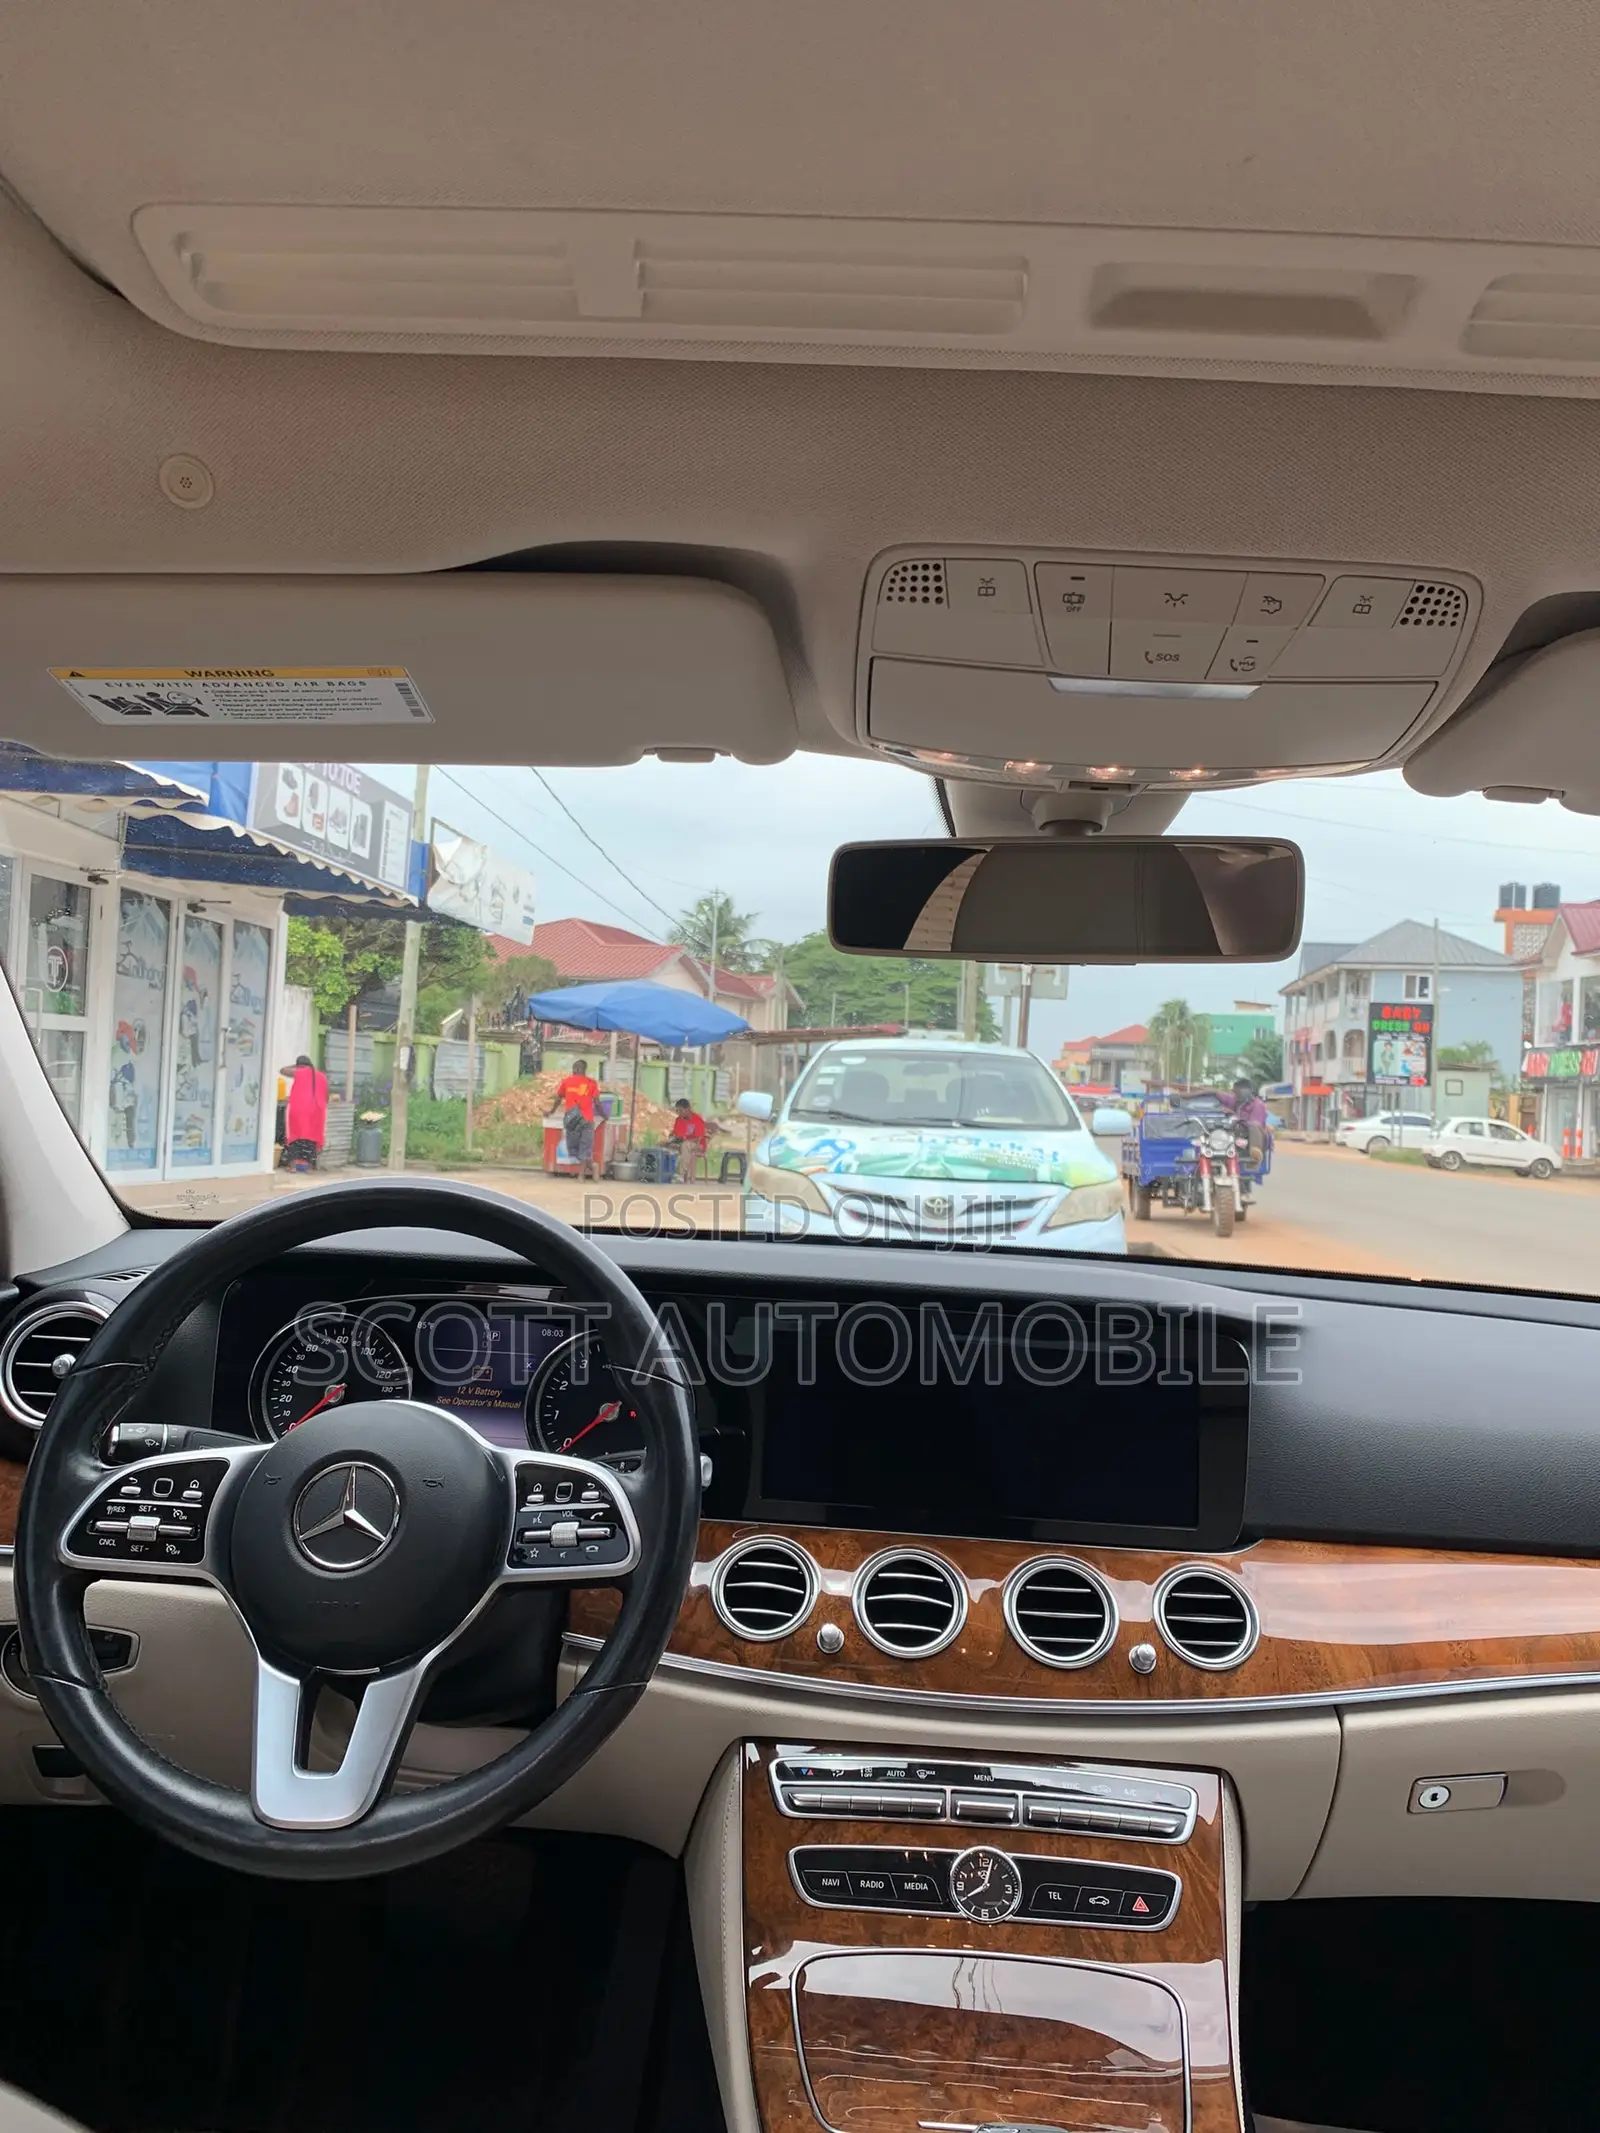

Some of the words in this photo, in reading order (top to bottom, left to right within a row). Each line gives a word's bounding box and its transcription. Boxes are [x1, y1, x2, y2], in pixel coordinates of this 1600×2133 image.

[1155, 652, 1180, 663] SOS
[184, 670, 275, 678] WARNING
[541, 1328, 564, 1337] 08:03
[336, 1336, 349, 1344] 80
[361, 1347, 376, 1356] 100
[374, 1358, 385, 1366] 110
[580, 1360, 588, 1369] 3
[285, 1366, 299, 1374] 40
[376, 1371, 392, 1379] 120
[559, 1380, 568, 1390] 2
[457, 1386, 465, 1394] 12
[475, 1387, 503, 1398] Battery
[279, 1395, 293, 1403] 20
[436, 1396, 452, 1405] See
[452, 1397, 492, 1407] Operator's
[492, 1400, 522, 1409] Manual
[554, 1410, 560, 1420] 1
[99, 1538, 117, 1547] CNCL
[973, 1774, 995, 1782] MENU
[979, 1858, 989, 1867] 12
[821, 1878, 840, 1887] NAVI
[860, 1880, 885, 1889] RADIO
[904, 1882, 929, 1891] MEDIA
[956, 1882, 965, 1891] 9
[1004, 1884, 1013, 1894] 3
[1047, 1891, 1062, 1900] TEL
[981, 1909, 989, 1919] 6
